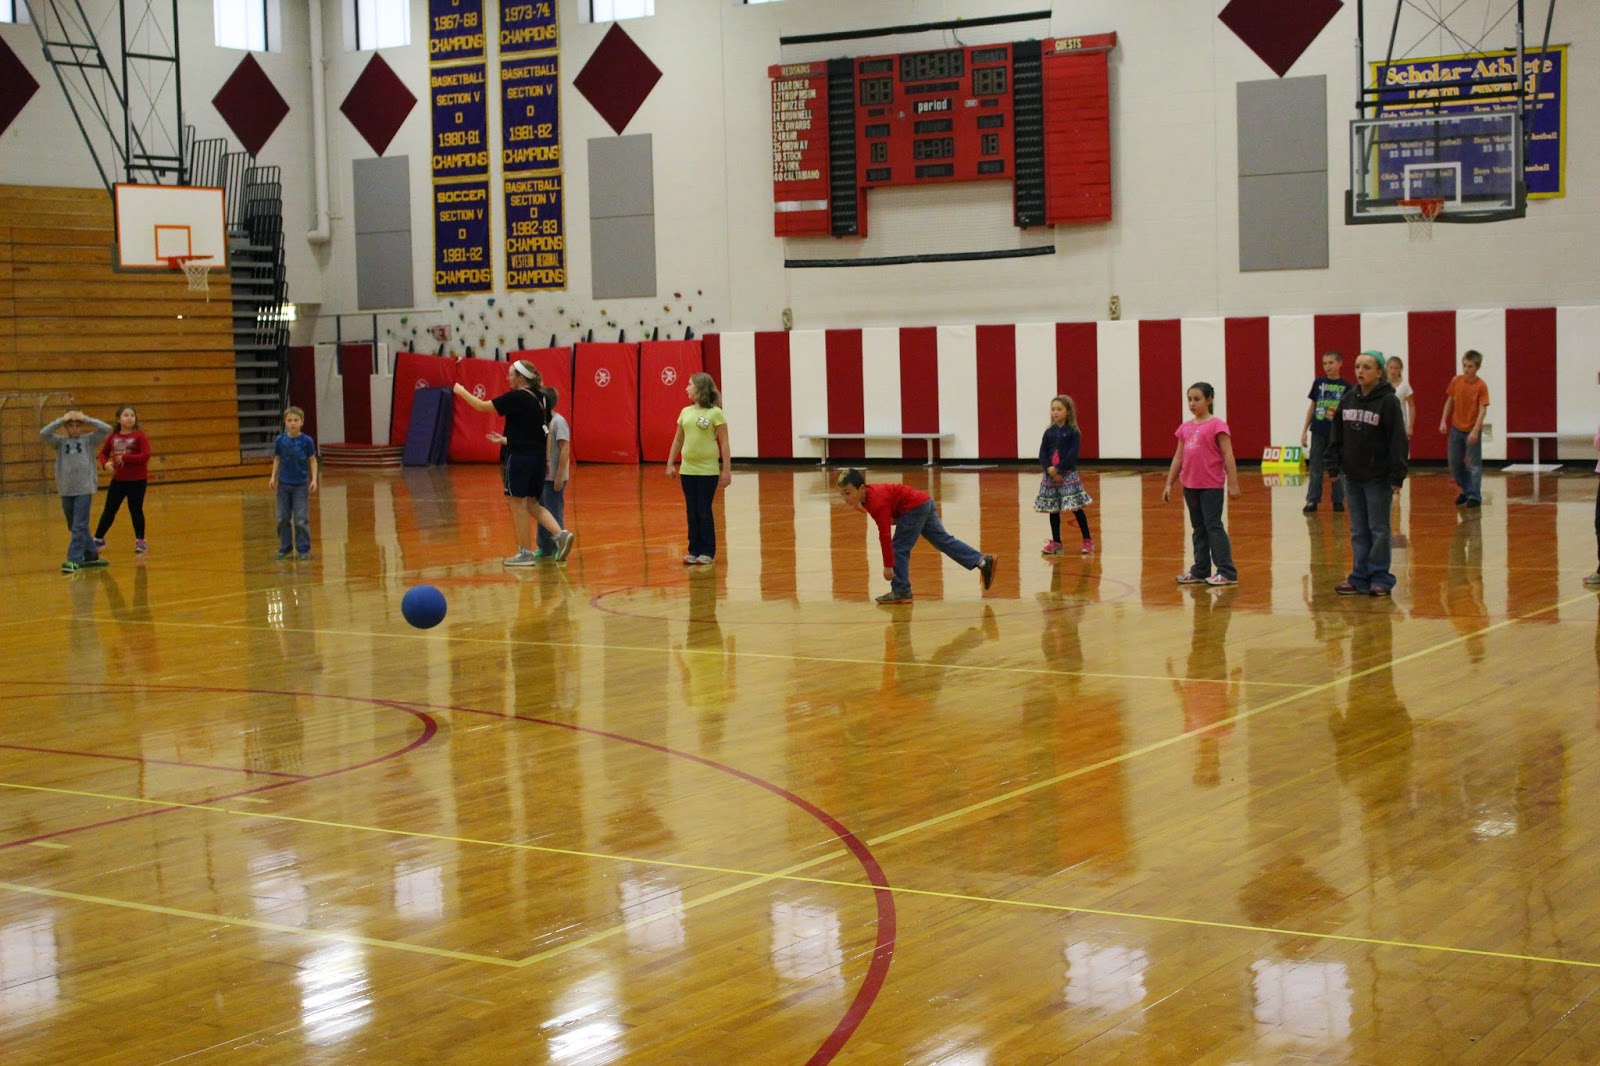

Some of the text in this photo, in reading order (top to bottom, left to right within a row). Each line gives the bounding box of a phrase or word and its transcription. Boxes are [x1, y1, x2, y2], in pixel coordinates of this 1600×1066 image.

[504, 3, 551, 22] 1973-74
[500, 24, 556, 45] CHAMPIONS
[430, 33, 483, 53] CHAMPIONS
[1055, 38, 1082, 50] GUESTS
[431, 72, 485, 87] BASKETBALL
[502, 64, 558, 80] BASKETBALL
[436, 91, 481, 106] SECTION V
[507, 84, 553, 99] SECTION V
[918, 98, 947, 114] period
[438, 130, 481, 147] 1980-81
[509, 123, 553, 141] 1981-82
[432, 151, 488, 169] CHAMPIONS
[503, 145, 559, 164] CHAMPIONS
[505, 179, 561, 193] BASKETBALL
[437, 189, 486, 203] SOCCER
[510, 192, 557, 206] SECTION V
[440, 208, 484, 222] SECTION V
[511, 219, 558, 236] 1982-83
[506, 235, 563, 253] CHAMPIONS
[443, 247, 483, 263] 1981-82
[435, 268, 490, 285] CHAMPIONS
[507, 268, 564, 285] CHAMPIONS
[1283, 448, 1299, 460] 01
